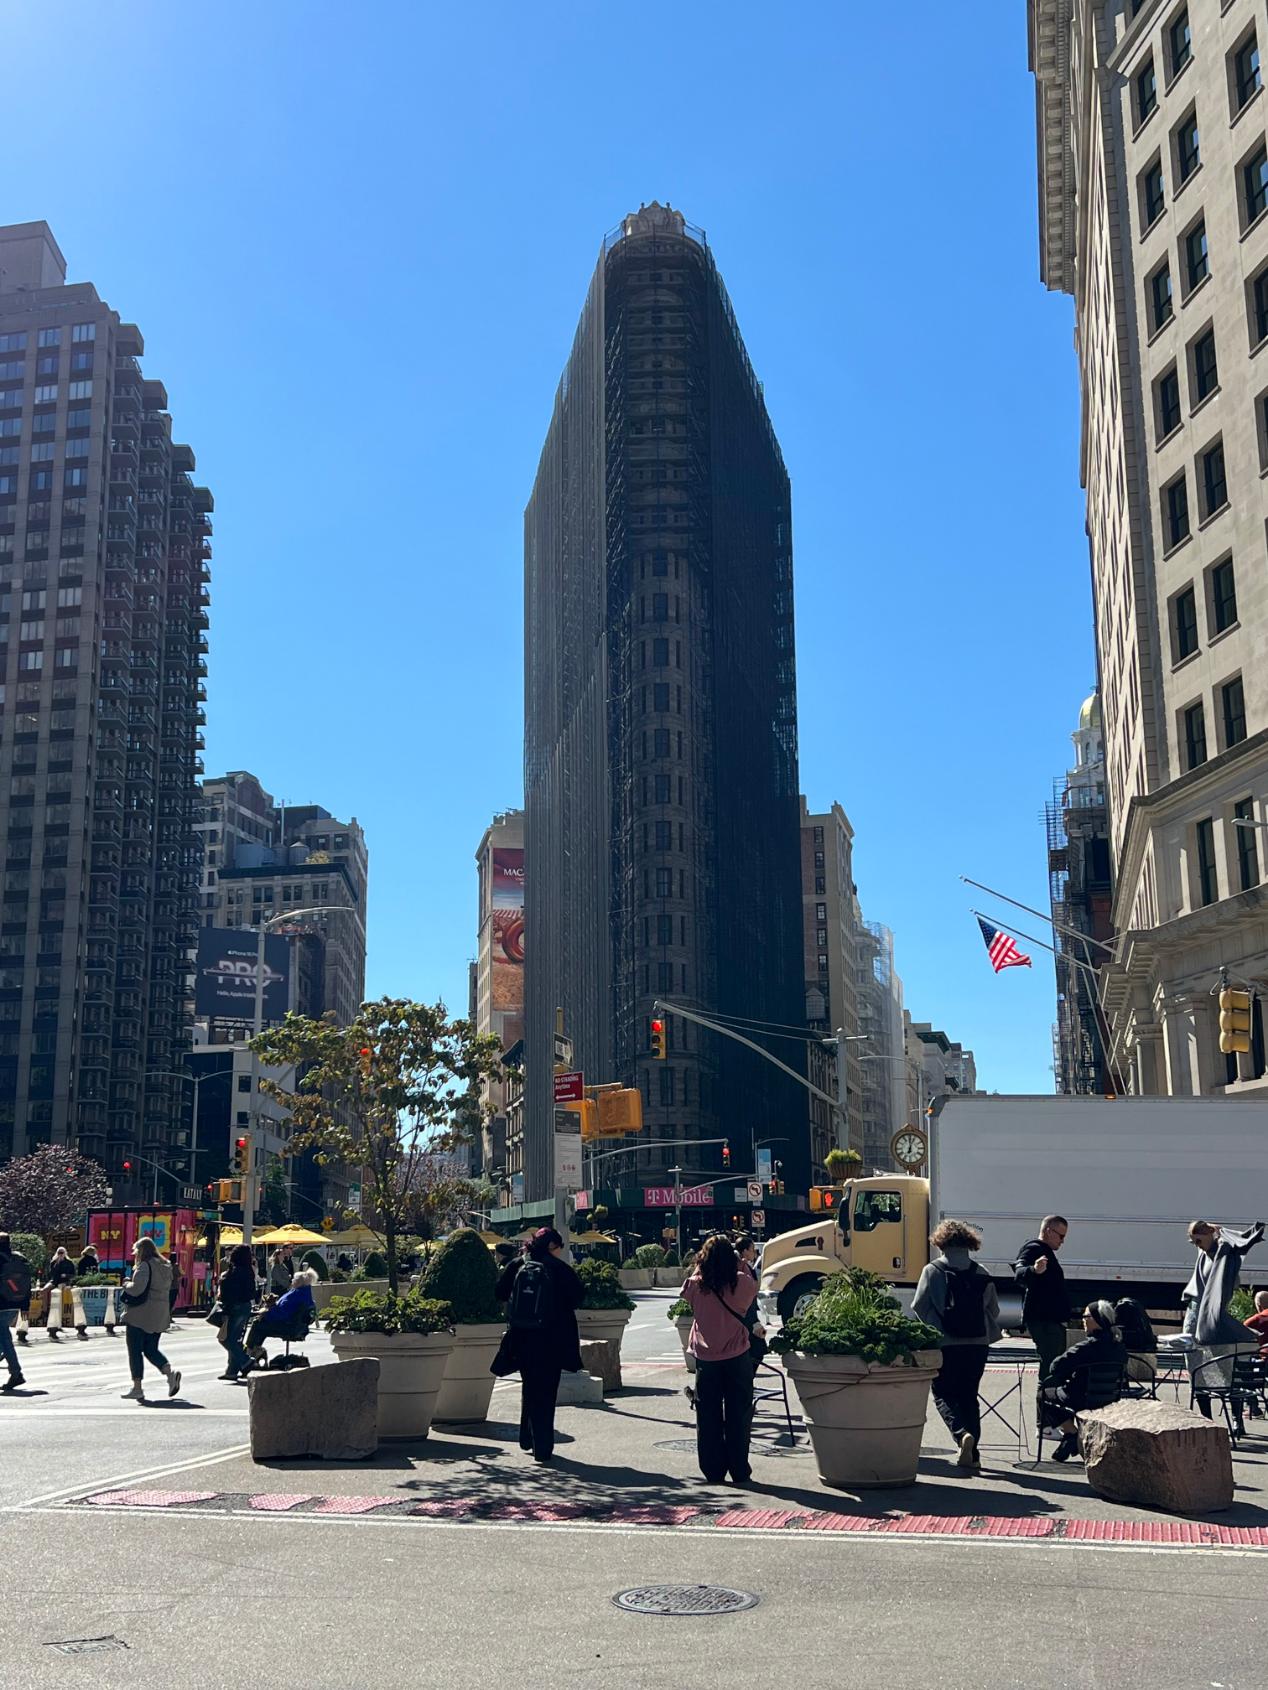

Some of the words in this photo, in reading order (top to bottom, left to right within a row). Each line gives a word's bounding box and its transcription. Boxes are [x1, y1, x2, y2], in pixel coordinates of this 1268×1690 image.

[218, 960, 272, 987] PRO
[100, 1230, 121, 1240] NY
[83, 1289, 98, 1299] THE
